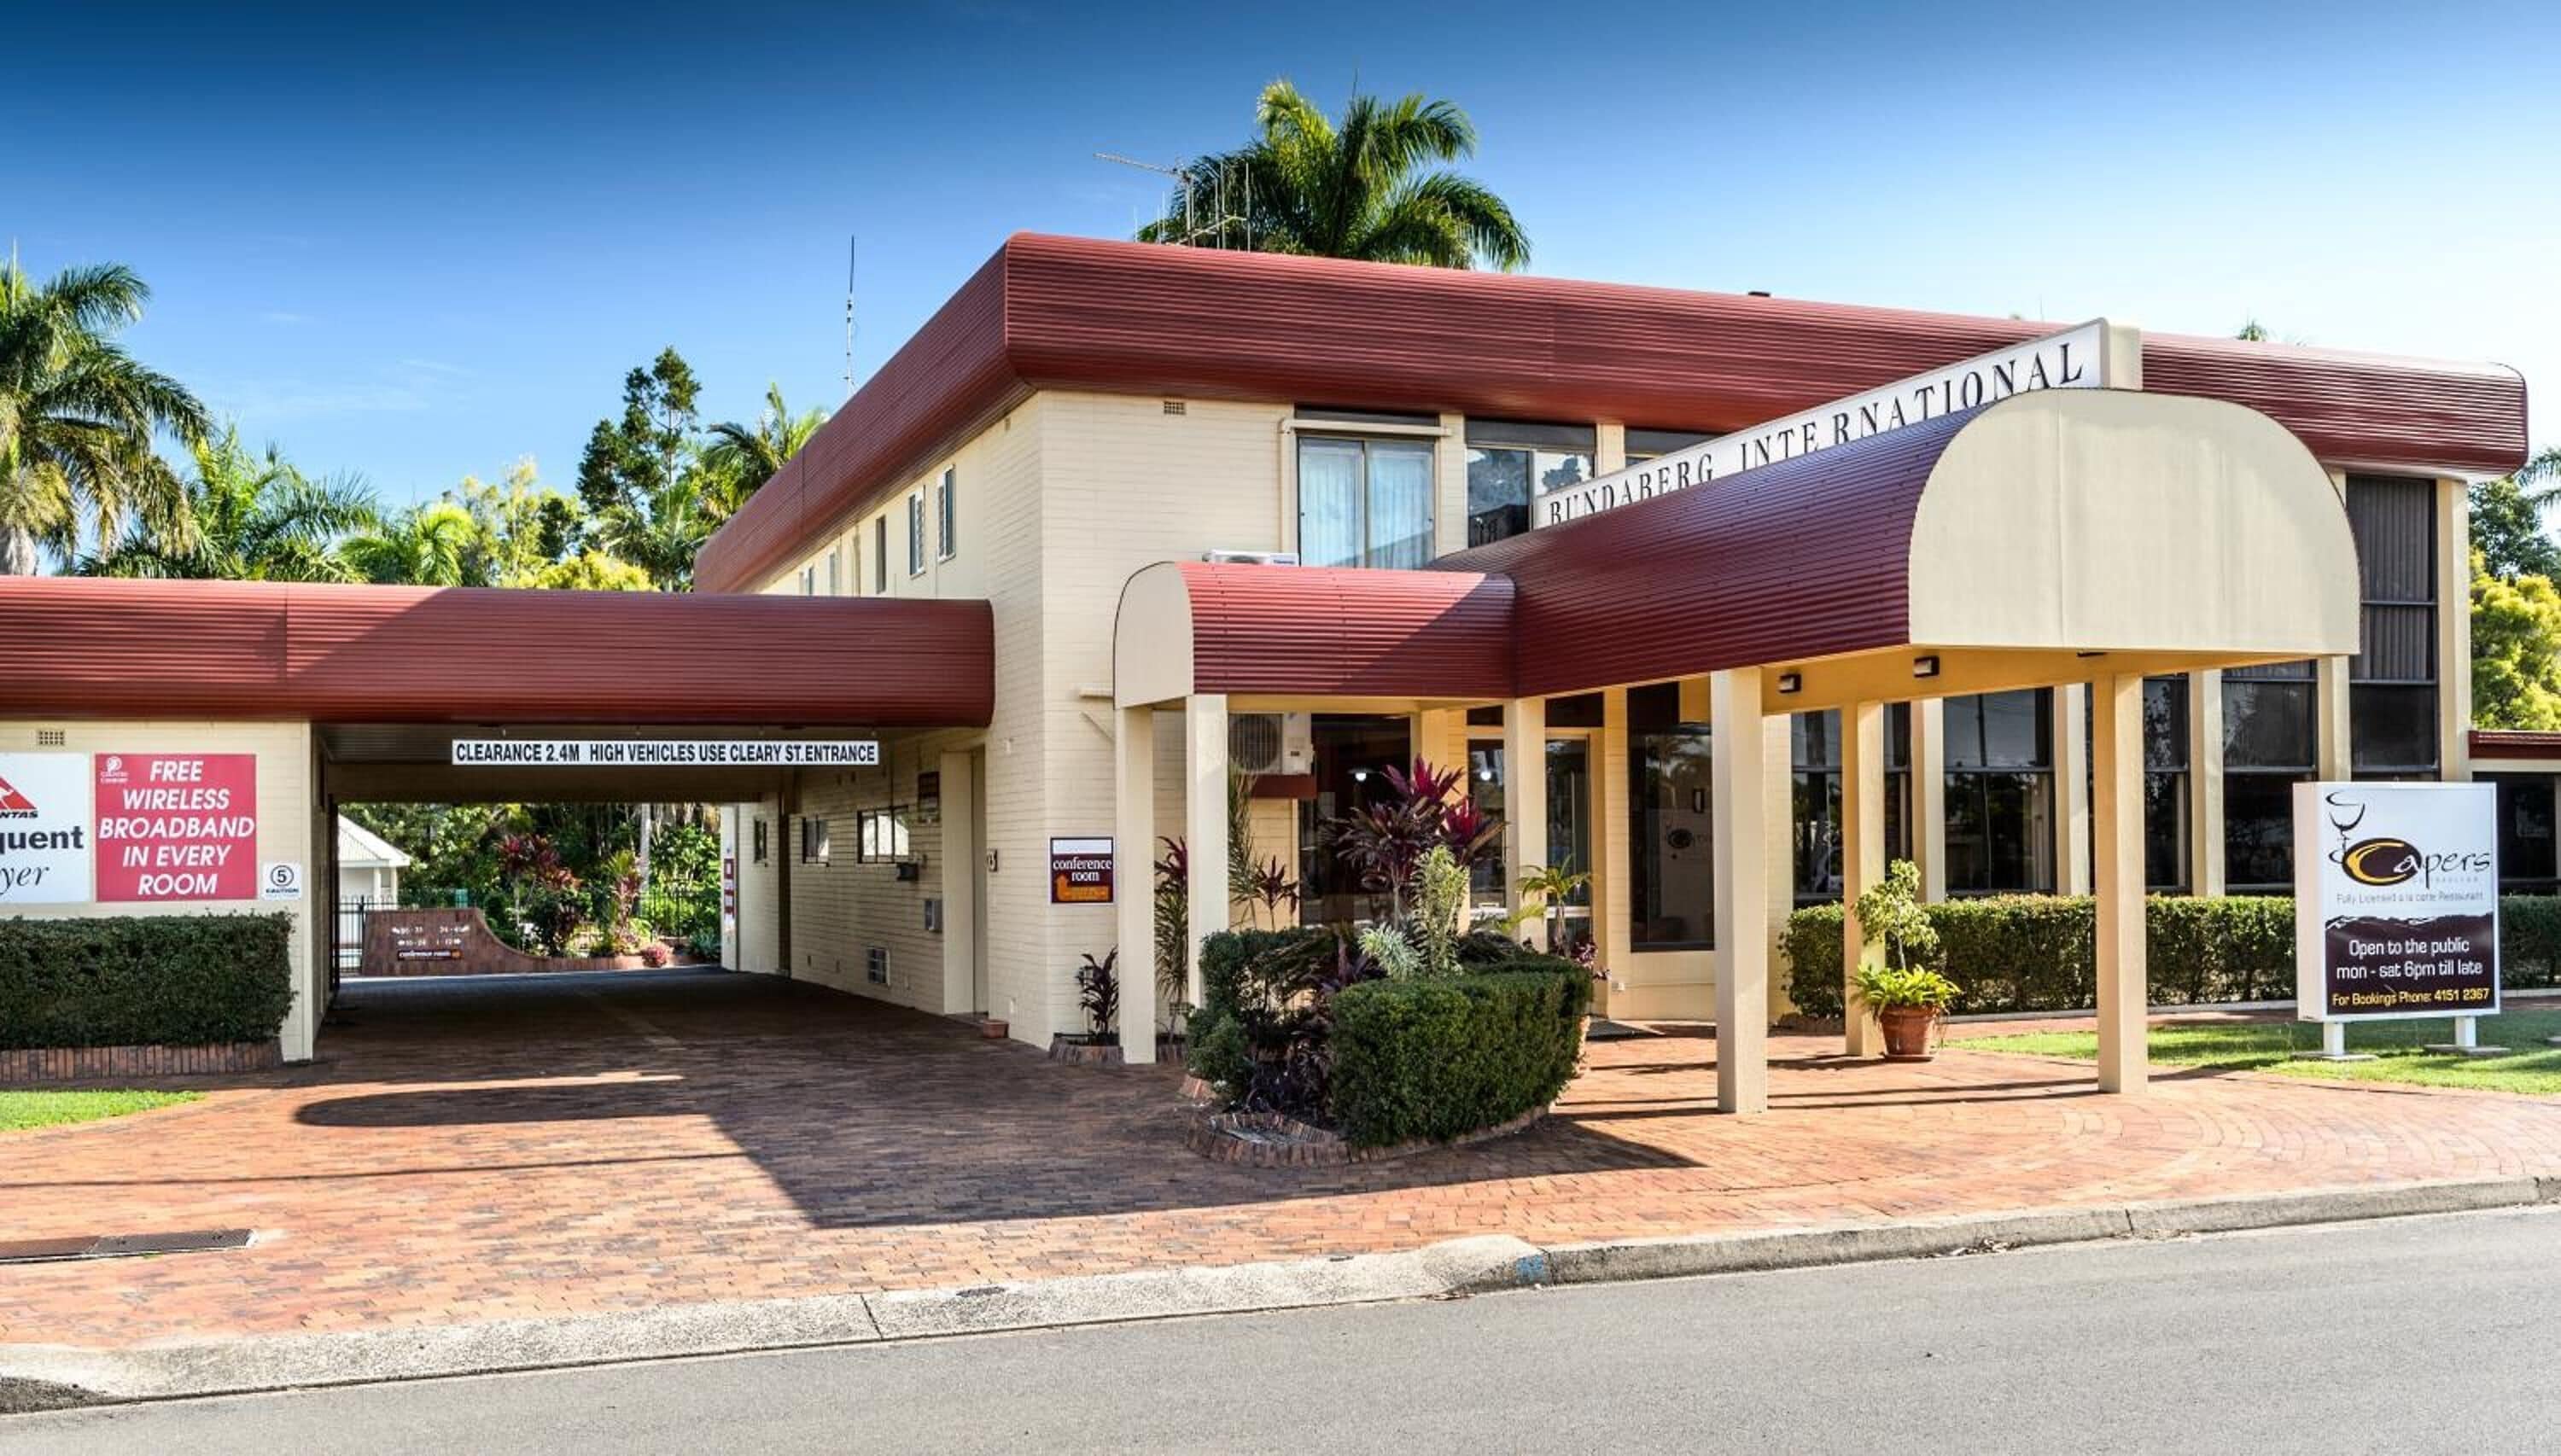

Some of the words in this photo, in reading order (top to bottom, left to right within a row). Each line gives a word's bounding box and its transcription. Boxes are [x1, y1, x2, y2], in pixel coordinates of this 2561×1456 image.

[1549, 453, 1714, 527] BUNDABERG
[1739, 342, 2084, 472] INTERNATIONAL
[457, 743, 541, 762] CLEARANCE
[545, 744, 580, 762] 2.4M
[590, 744, 624, 762] HIGH
[627, 744, 695, 762] VEHICLES
[699, 744, 726, 762] USE
[730, 744, 781, 762] CLEARY
[150, 760, 204, 783] FREE
[123, 789, 230, 810] WIRELESS
[99, 817, 255, 839] BROADBAND
[123, 846, 149, 868] IN
[156, 845, 232, 868] EVERY
[1053, 856, 1112, 870] conference
[2347, 842, 2490, 889] Capers
[138, 873, 219, 895] ROOM
[277, 870, 288, 883] 5
[1071, 871, 1100, 882] room
[2349, 940, 2384, 960] Open
[2388, 940, 2403, 955] to
[2405, 938, 2428, 954] the
[2431, 936, 2470, 957] public
[2336, 966, 2367, 980] mon
[2379, 964, 2402, 978] sat
[2404, 961, 2436, 981] 6pm
[2438, 959, 2455, 976] till
[2458, 958, 2483, 976] late
[2332, 993, 2349, 1006] For
[2352, 992, 2397, 1007] Bookings
[2434, 988, 2459, 1001] 4151
